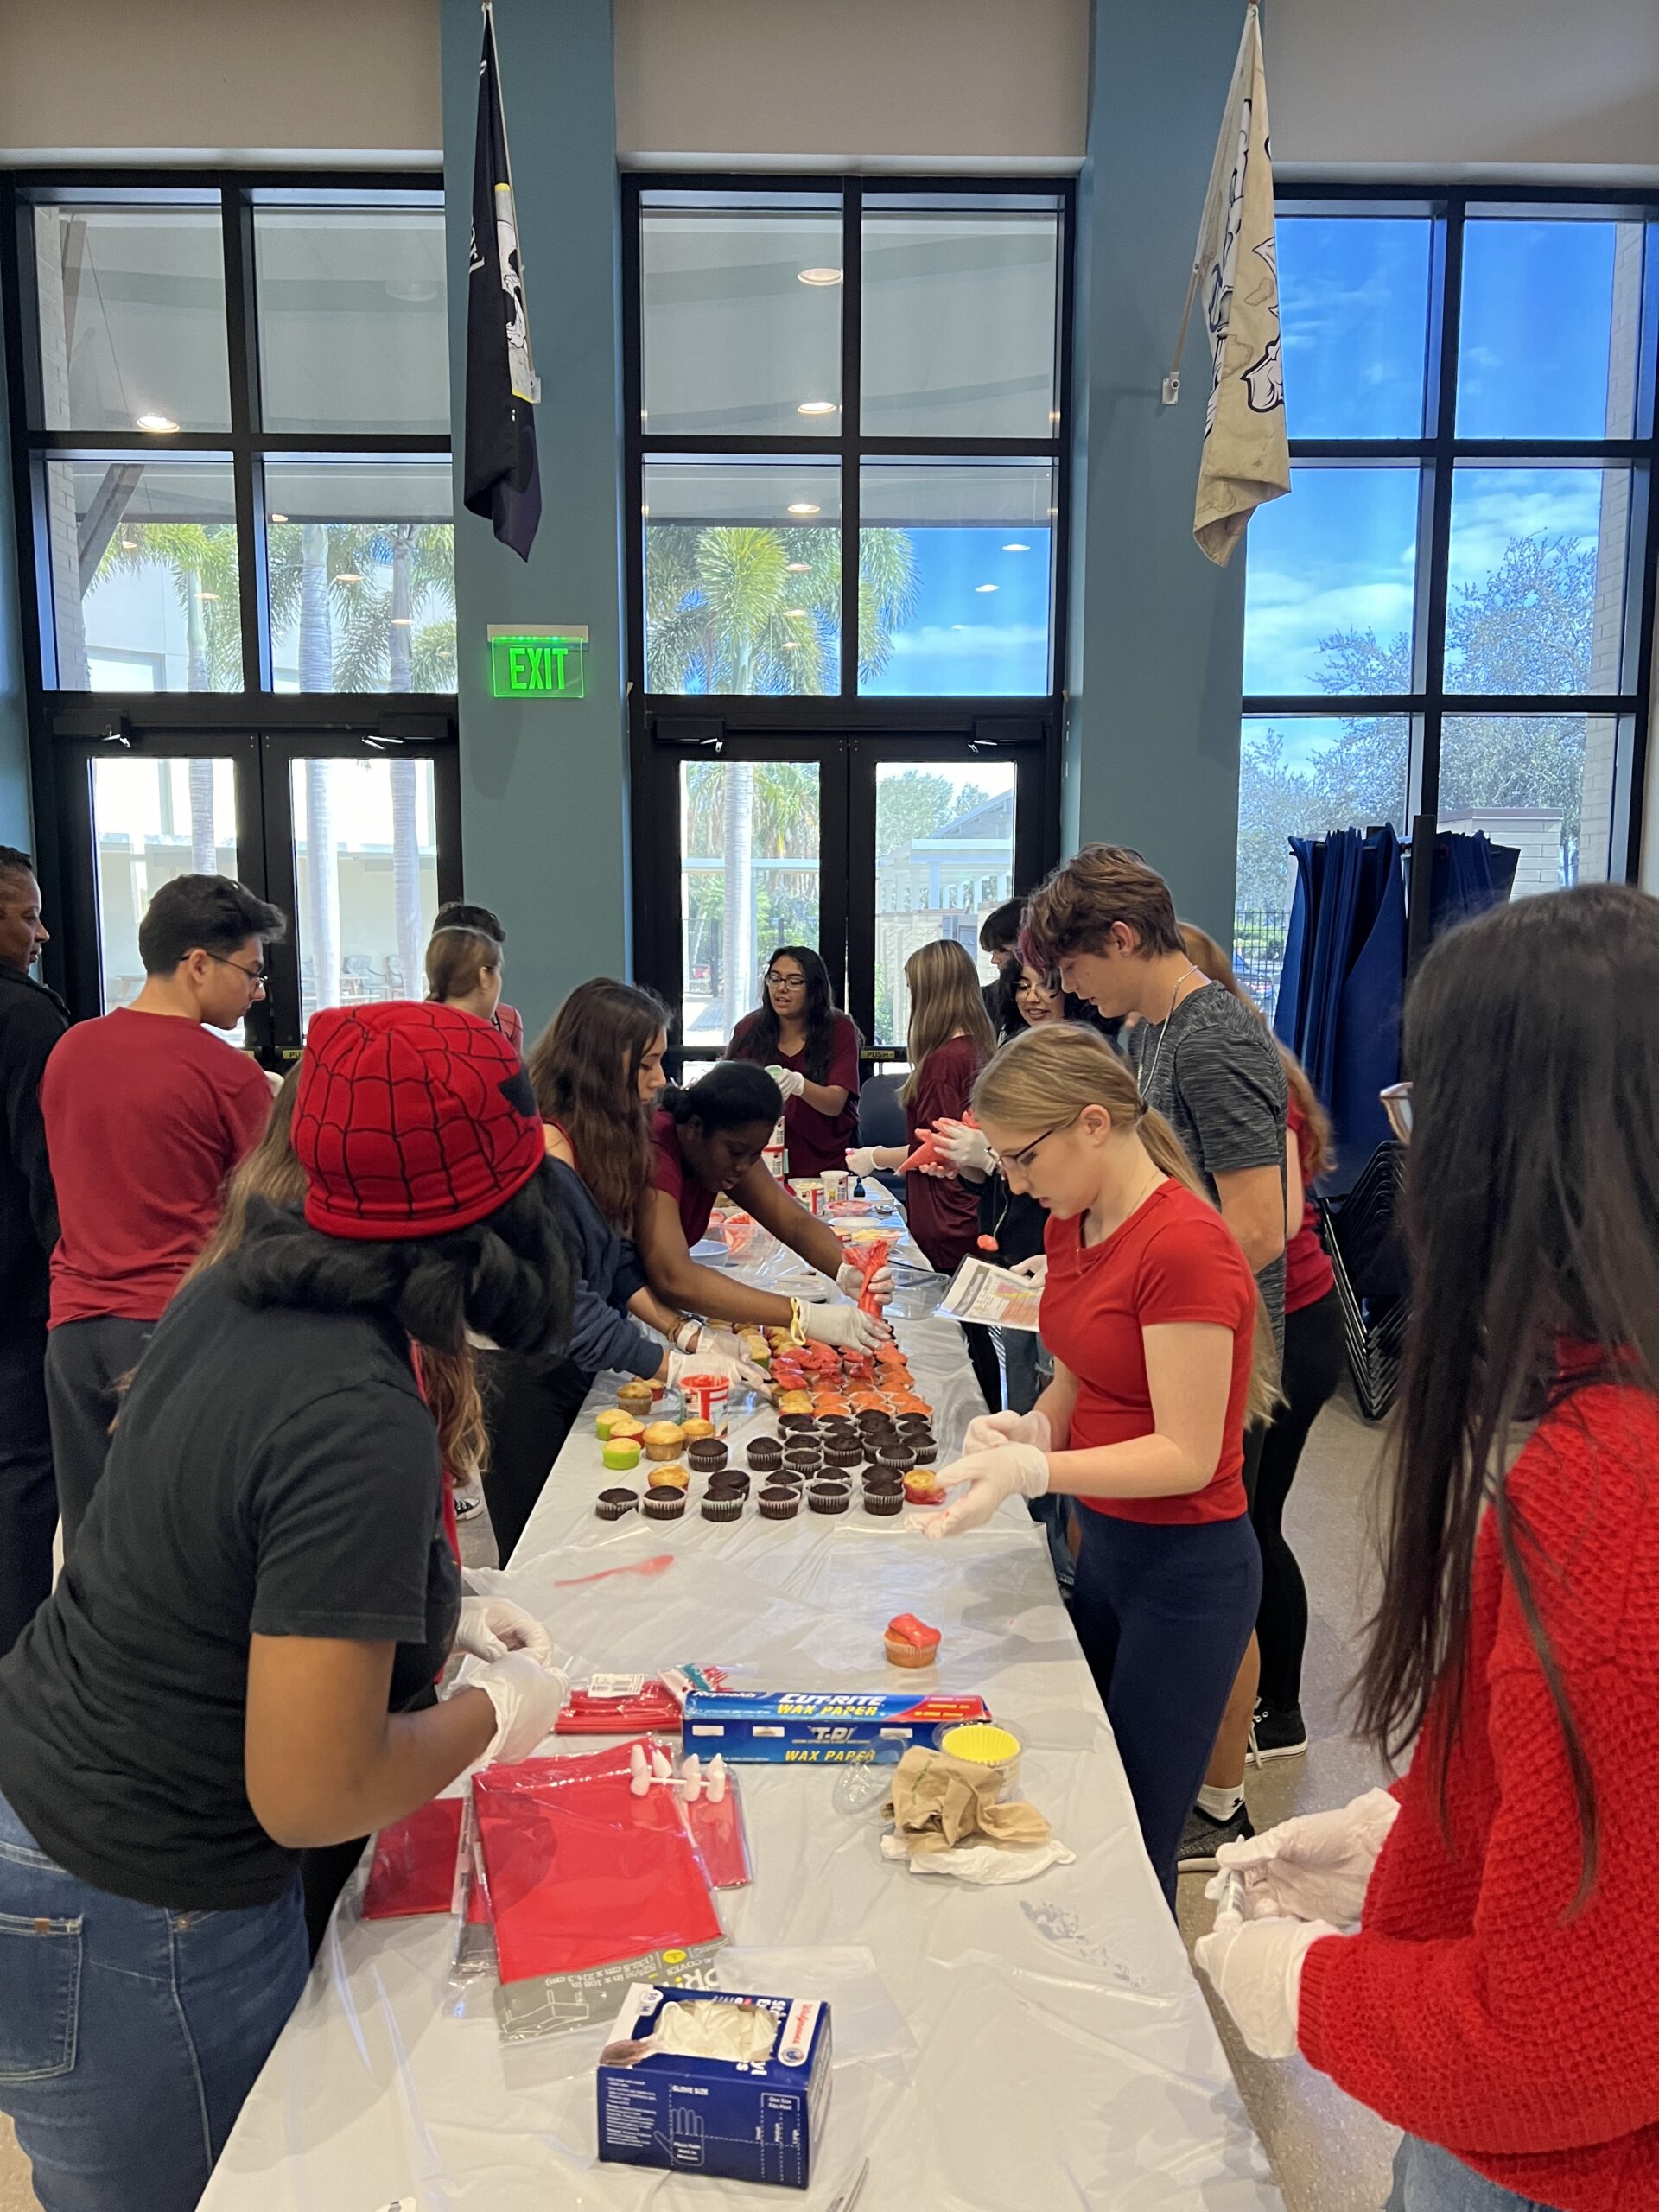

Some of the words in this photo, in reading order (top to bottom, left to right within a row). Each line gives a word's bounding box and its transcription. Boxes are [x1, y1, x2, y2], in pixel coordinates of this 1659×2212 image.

[509, 647, 569, 690] EXIT
[779, 1693, 887, 1707] CUT-RITE
[777, 1704, 816, 1715] WAX
[820, 1705, 879, 1717] PAPER
[785, 1750, 820, 1762] WAX
[823, 1750, 876, 1763] PAPER
[665, 1958, 703, 1977] COVER
